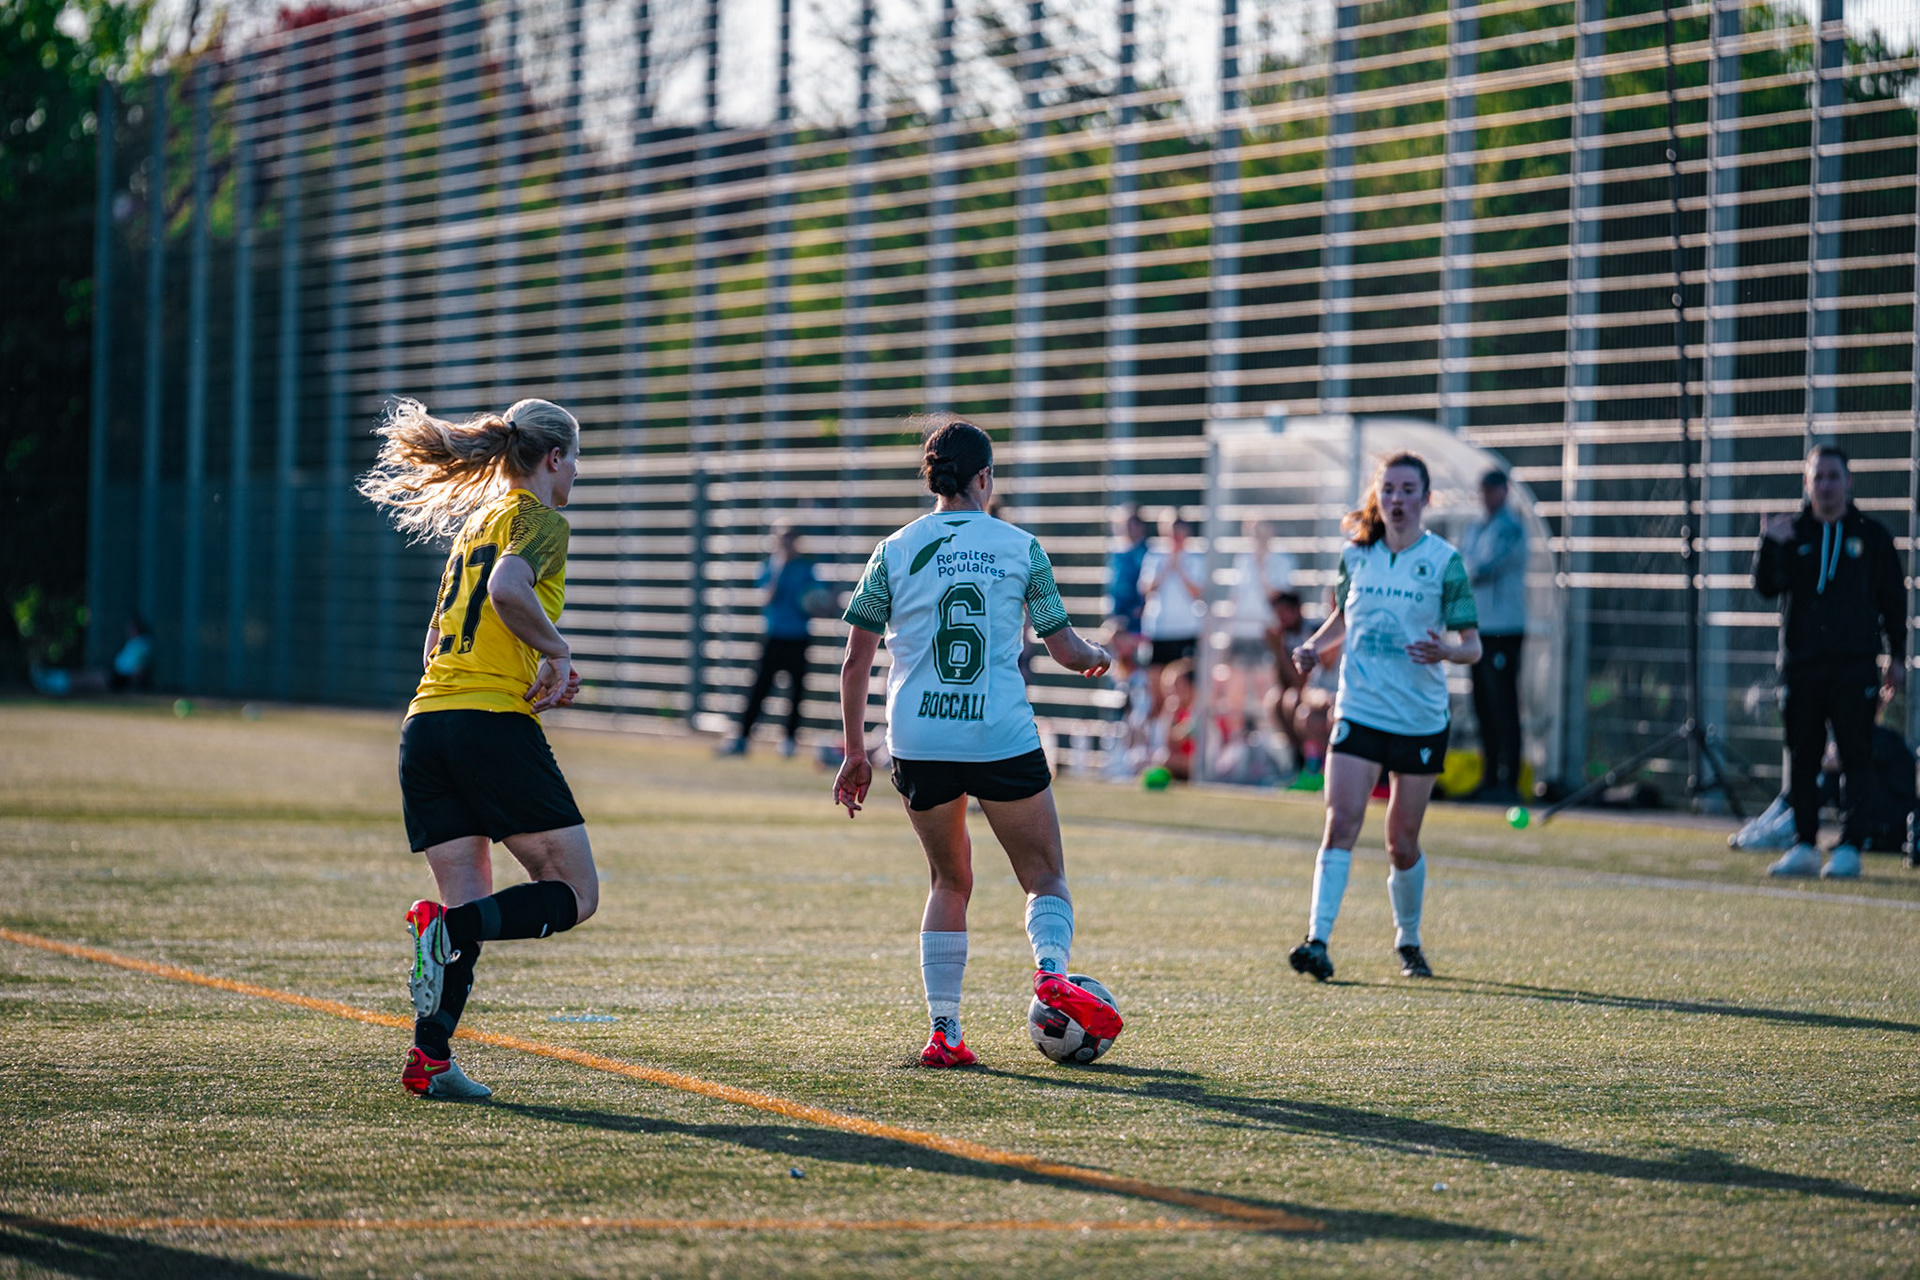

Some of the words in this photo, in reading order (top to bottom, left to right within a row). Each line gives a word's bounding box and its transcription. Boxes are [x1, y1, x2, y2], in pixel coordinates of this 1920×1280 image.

[938, 561, 1005, 578] Poulaires
[932, 582, 986, 685] 6
[917, 690, 986, 721] BOCCALI
